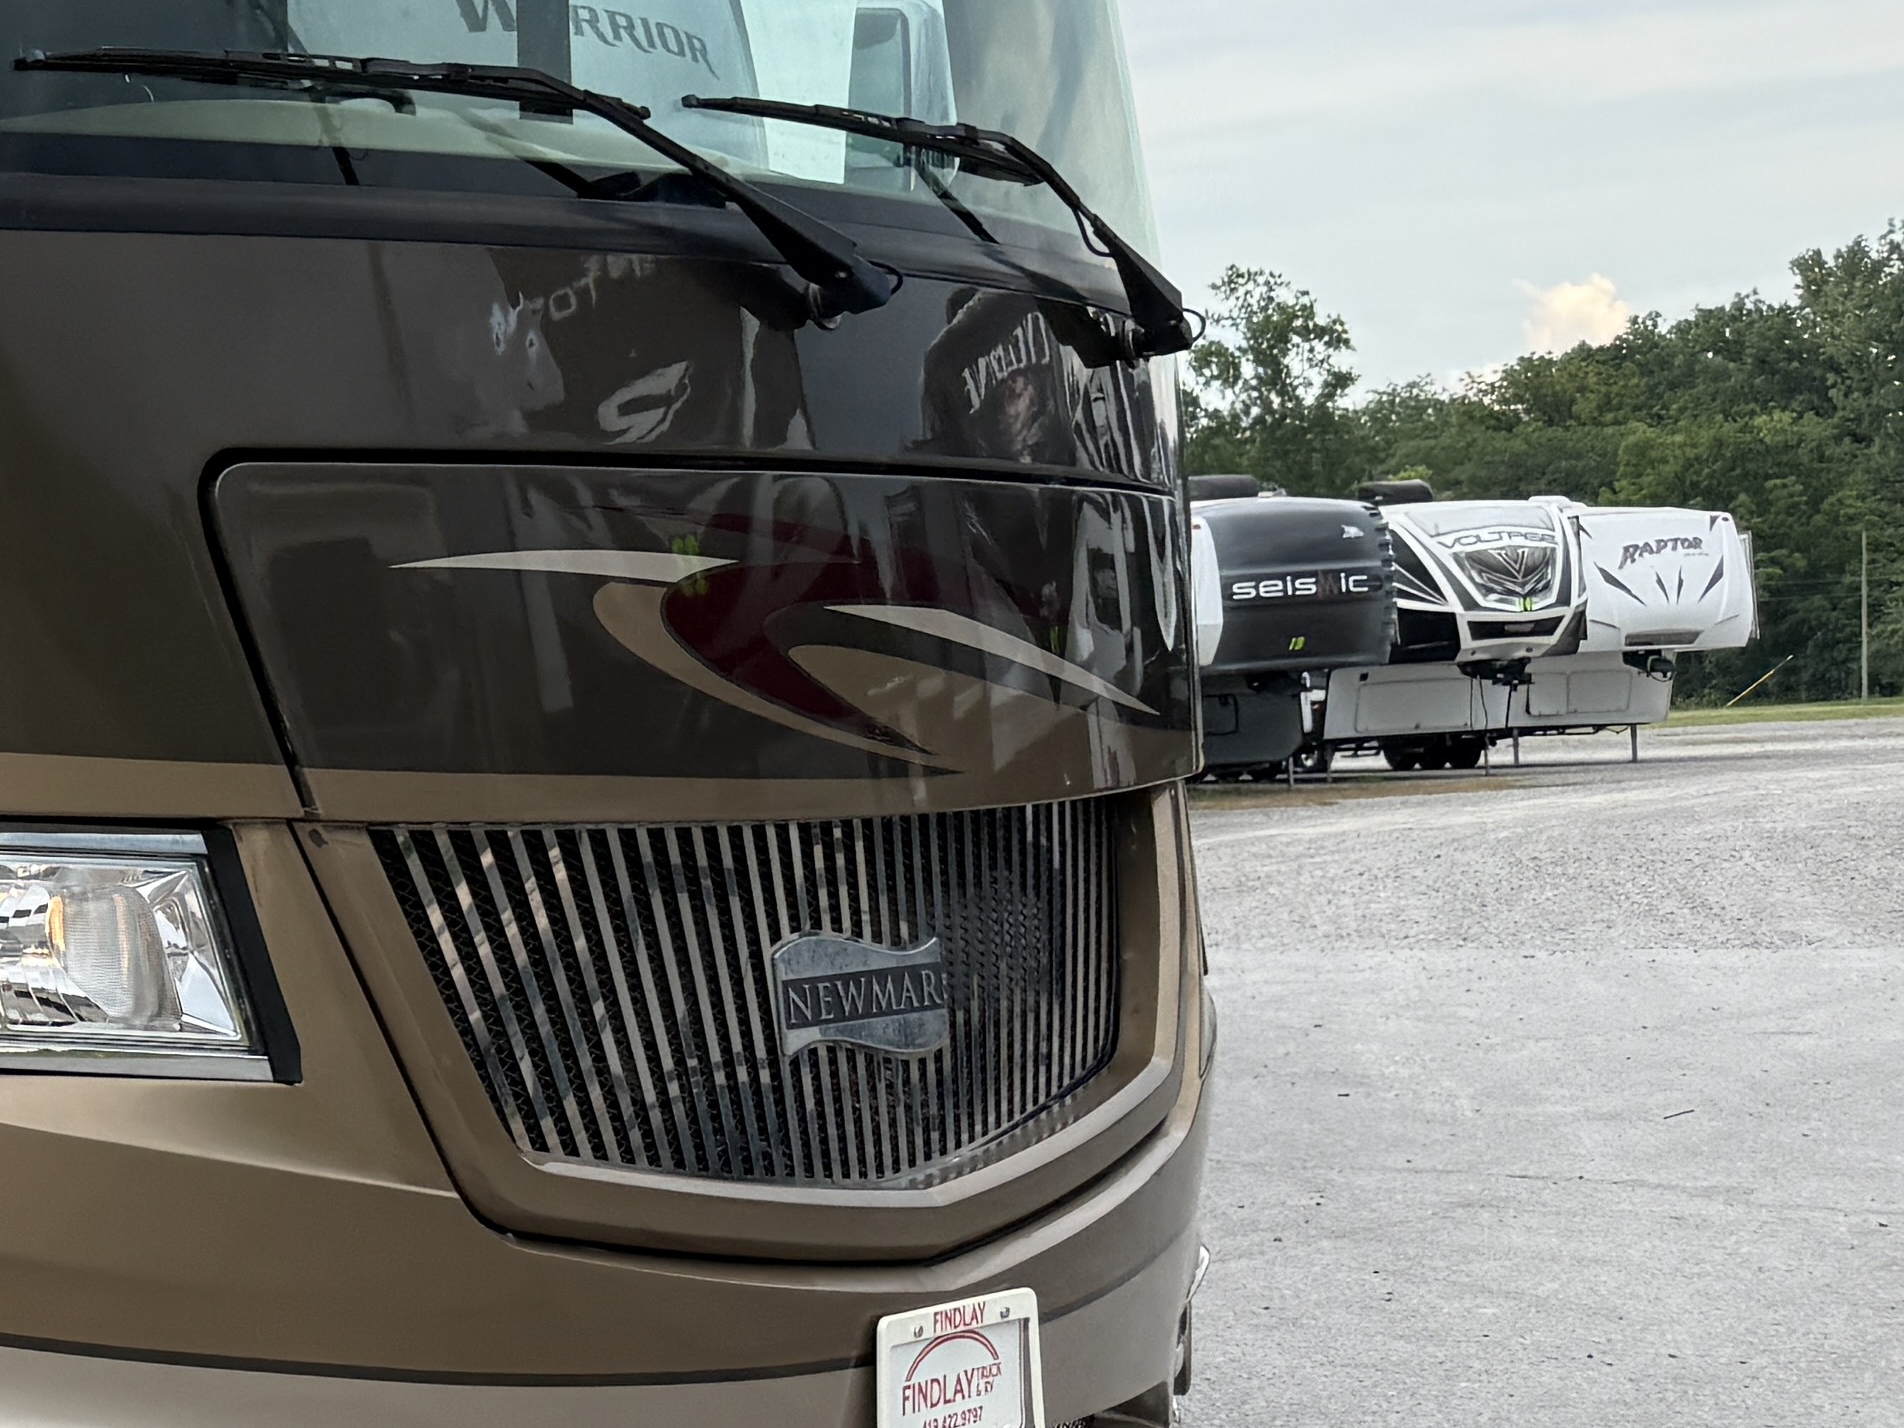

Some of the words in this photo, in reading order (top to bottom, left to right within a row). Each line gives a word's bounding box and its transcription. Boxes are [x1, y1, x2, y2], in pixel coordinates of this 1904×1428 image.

[1617, 536, 1704, 570] RAPTOR
[788, 970, 944, 1024] NEWMAR
[933, 1302, 986, 1333] FINDLAY
[902, 1367, 975, 1416] FINDLAY
